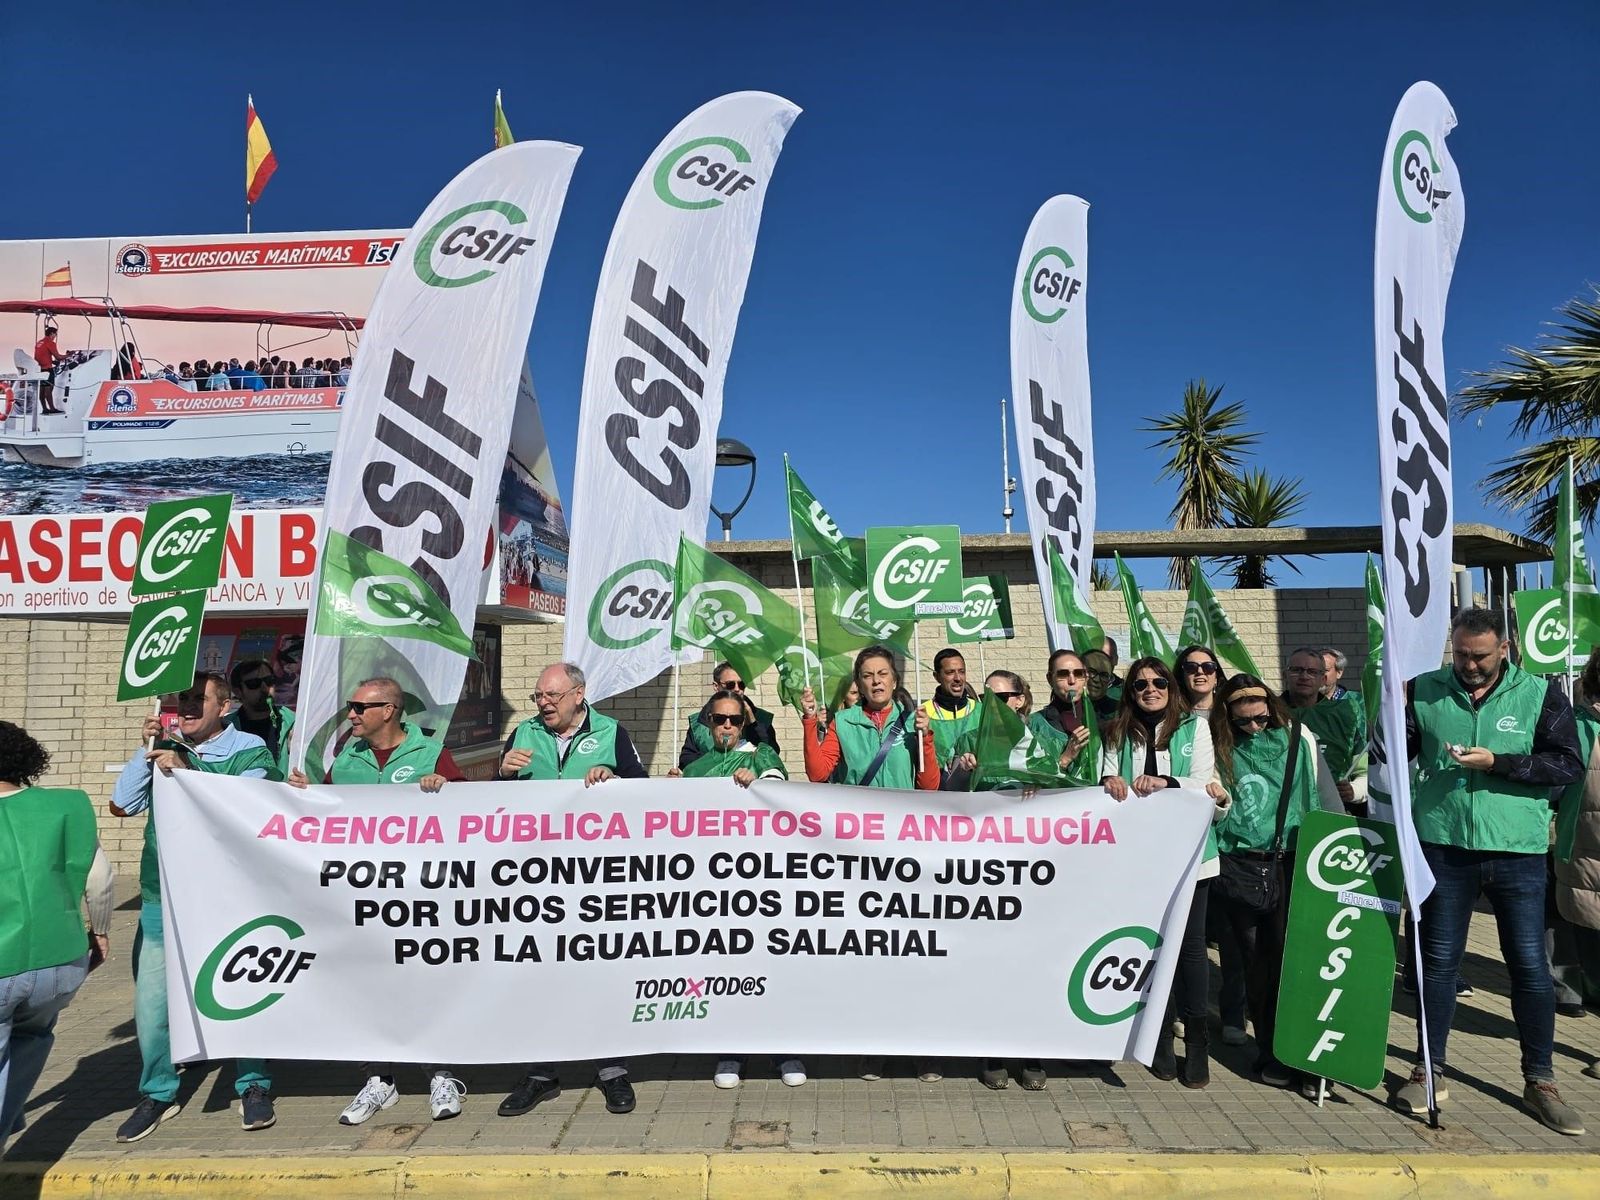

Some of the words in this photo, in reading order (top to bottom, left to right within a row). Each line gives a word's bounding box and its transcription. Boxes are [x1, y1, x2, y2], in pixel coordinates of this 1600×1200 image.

[677, 155, 756, 197] CSIF
[159, 246, 259, 267] EXCURSIONES
[264, 244, 353, 264] MARÍTIMAS
[440, 225, 536, 265] CSIF
[1033, 267, 1082, 304] CSIF
[157, 396, 246, 411] EXCURSIONES
[251, 391, 325, 408] MARÍTIMAS
[605, 258, 710, 510] CSIF
[156, 527, 217, 558] CSIF
[888, 558, 950, 585] CSIF
[24, 587, 88, 611] aperitivo
[98, 586, 117, 605] de
[276, 587, 285, 606] y
[529, 591, 559, 613] PASEOS
[138, 625, 193, 661] CSIF
[257, 813, 445, 845] AGENCIA
[458, 807, 631, 844] PÚBLICA
[644, 809, 821, 839] PUERTOS
[835, 812, 886, 841] DE
[898, 811, 1117, 845] ANDALUCÍA
[320, 860, 405, 889] POR
[419, 859, 476, 889] UN
[490, 853, 695, 887] CONVENIO
[708, 851, 922, 883] COLECTIVO
[934, 857, 1056, 887] JUSTO
[1323, 845, 1394, 876] CSIF
[354, 899, 439, 927] POR
[454, 896, 566, 925] UNOS
[578, 889, 782, 923] SERVICIOS
[795, 890, 844, 918] DE
[858, 891, 1022, 921] CALIDAD
[1341, 891, 1398, 914] Huelva
[221, 944, 317, 984] CSIF
[394, 937, 480, 965] POR
[494, 934, 542, 963] LA
[556, 928, 754, 962] IGUALDAD
[767, 928, 948, 957] SALARIAL
[1089, 955, 1157, 994] CSI
[1306, 906, 1361, 1062] CSIF
[631, 1003, 658, 1022] ES
[662, 996, 710, 1021] MÁS
